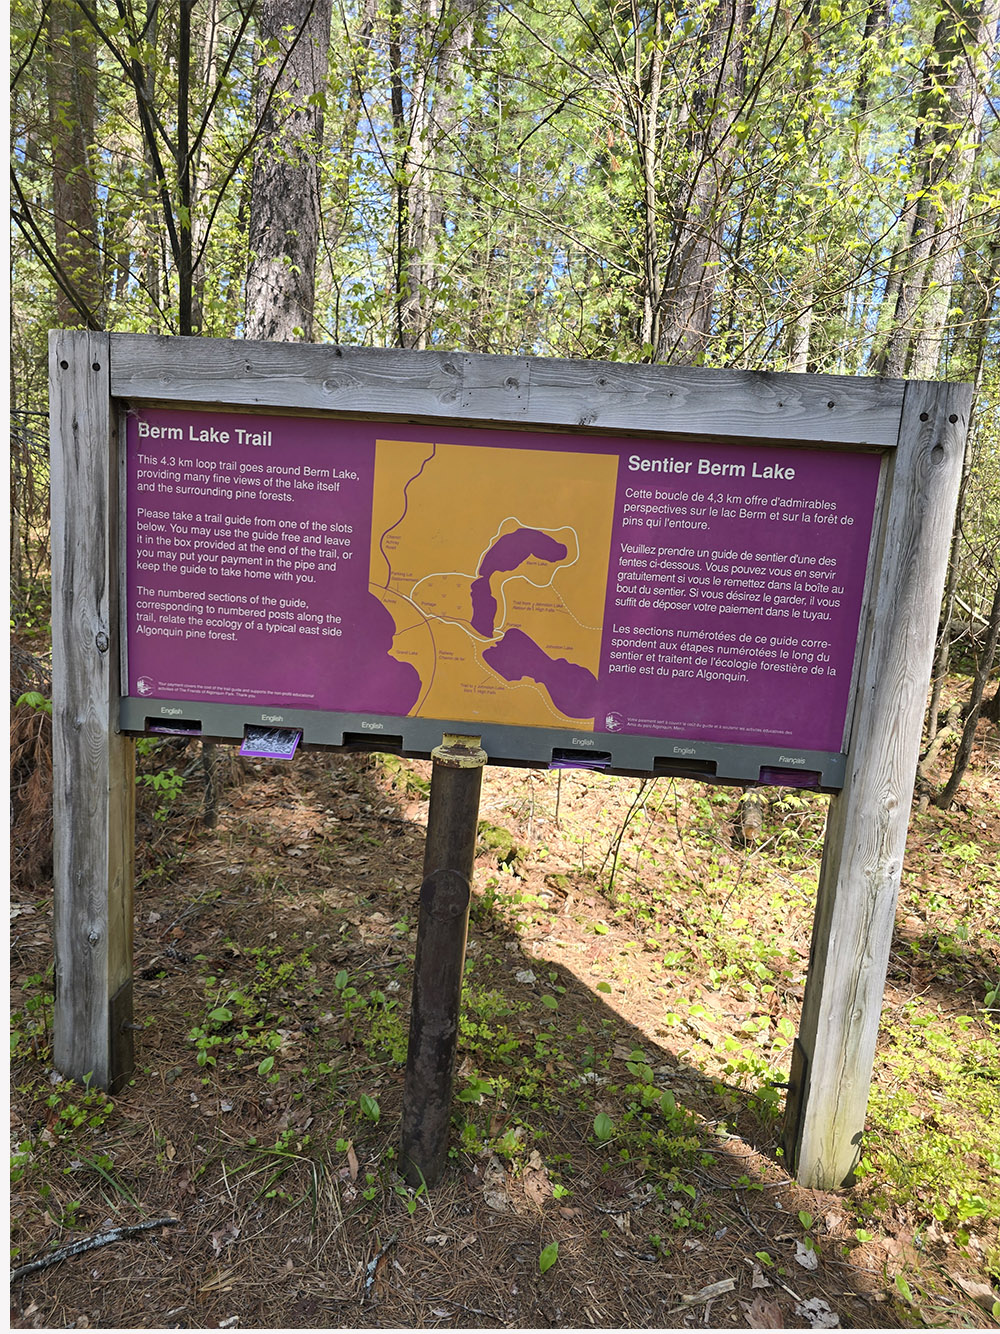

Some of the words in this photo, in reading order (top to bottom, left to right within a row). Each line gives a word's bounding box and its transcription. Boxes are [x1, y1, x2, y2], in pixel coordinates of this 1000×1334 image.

[138, 422, 183, 440] Berm
[189, 425, 230, 444] Lake
[234, 428, 272, 446] Trail
[137, 453, 158, 465] This
[160, 456, 176, 466] 4.3
[178, 456, 193, 467] km
[195, 458, 217, 471] loop
[218, 460, 237, 470] trail
[239, 463, 264, 474] goes
[265, 465, 301, 475] around
[303, 465, 330, 477] Berm
[332, 468, 359, 481] Lake,
[627, 454, 693, 474] Sentier
[697, 458, 746, 477] Berm
[751, 461, 795, 480] Lake
[136, 468, 181, 482] providing
[183, 472, 210, 484] many
[212, 472, 231, 484] fine
[232, 474, 261, 486] views
[263, 476, 273, 487] of
[275, 477, 291, 488] the
[293, 478, 314, 490] lake
[316, 480, 340, 491] itself
[136, 481, 155, 492] and
[157, 482, 173, 493] the
[175, 485, 233, 499] surrounding
[235, 488, 256, 500] pine
[258, 489, 294, 502] forests.
[624, 487, 652, 499] Cette
[654, 489, 689, 501] boucle
[690, 491, 705, 502] de
[706, 492, 724, 504] 4,3
[725, 493, 742, 504] km
[744, 494, 768, 506] offre
[770, 496, 836, 510] d'admirables
[137, 507, 170, 519] Please
[172, 510, 193, 521] take
[195, 513, 202, 522] a
[204, 513, 222, 523] trail
[224, 514, 252, 526] guide
[253, 516, 276, 527] from
[278, 519, 297, 529] one
[299, 519, 310, 530] of
[311, 520, 328, 531] the
[329, 522, 353, 533] slots
[621, 515, 643, 527] pins
[645, 516, 662, 529] qui
[663, 517, 710, 530] l'entoure.
[623, 503, 687, 515] perspectives
[689, 507, 707, 516] sur
[708, 506, 718, 516] le
[720, 506, 736, 518] lac
[738, 507, 767, 519] Berm
[769, 511, 780, 520] et
[781, 512, 800, 521] sur
[801, 512, 811, 523] la
[813, 512, 838, 524] forêt
[839, 514, 854, 525] de
[620, 542, 656, 554] Veuillez
[657, 546, 695, 557] prendre
[696, 549, 710, 558] un
[710, 549, 738, 561] guide
[739, 550, 753, 561] de
[754, 552, 788, 563] sentier
[789, 553, 816, 565] d'une
[817, 555, 836, 566] des
[136, 585, 155, 596] The
[157, 588, 206, 600] numbered
[207, 592, 247, 603] sections
[249, 594, 259, 604] of
[261, 595, 277, 606] the
[278, 597, 309, 609] guide,
[135, 600, 203, 615] corresponding
[205, 604, 215, 614] to
[217, 606, 266, 618] numbered
[267, 610, 294, 620] posts
[296, 611, 324, 624] along
[325, 613, 342, 624] the
[135, 624, 183, 638] Algonquin
[185, 628, 206, 639] pine
[208, 629, 237, 641] forest.
[136, 612, 156, 623] trail,
[159, 614, 186, 624] relate
[187, 615, 203, 625] the
[205, 618, 243, 631] ecology
[244, 619, 255, 629] of
[256, 622, 263, 630] a
[265, 622, 296, 633] typical
[298, 625, 320, 635] east
[321, 626, 342, 637] side
[612, 623, 630, 634] Les
[632, 626, 674, 637] sections
[676, 629, 736, 641] numérotées
[738, 632, 752, 643] de
[754, 635, 767, 644] ce
[769, 635, 798, 647] guide
[800, 639, 831, 648] corre-
[610, 638, 657, 649] spondent
[658, 641, 678, 650] aux
[679, 641, 714, 654] étapes
[716, 645, 777, 658] numérotées
[779, 648, 789, 659] le
[791, 649, 814, 663] long
[816, 652, 830, 662] du
[608, 663, 637, 674] partie
[638, 665, 654, 675] est
[656, 665, 669, 676] du
[671, 668, 695, 678] parc
[695, 668, 749, 683] Algonquin.
[609, 650, 644, 661] sentier
[645, 653, 656, 662] et
[657, 653, 693, 665] traitent
[694, 655, 708, 666] de
[710, 656, 757, 671] l'écologie
[760, 660, 808, 674] forestière
[810, 664, 824, 675] de
[826, 665, 836, 676] la
[161, 707, 183, 715] English
[261, 714, 284, 722] English
[361, 722, 384, 730] English
[572, 737, 594, 747] English
[673, 746, 696, 755] English
[778, 756, 805, 764] Français
